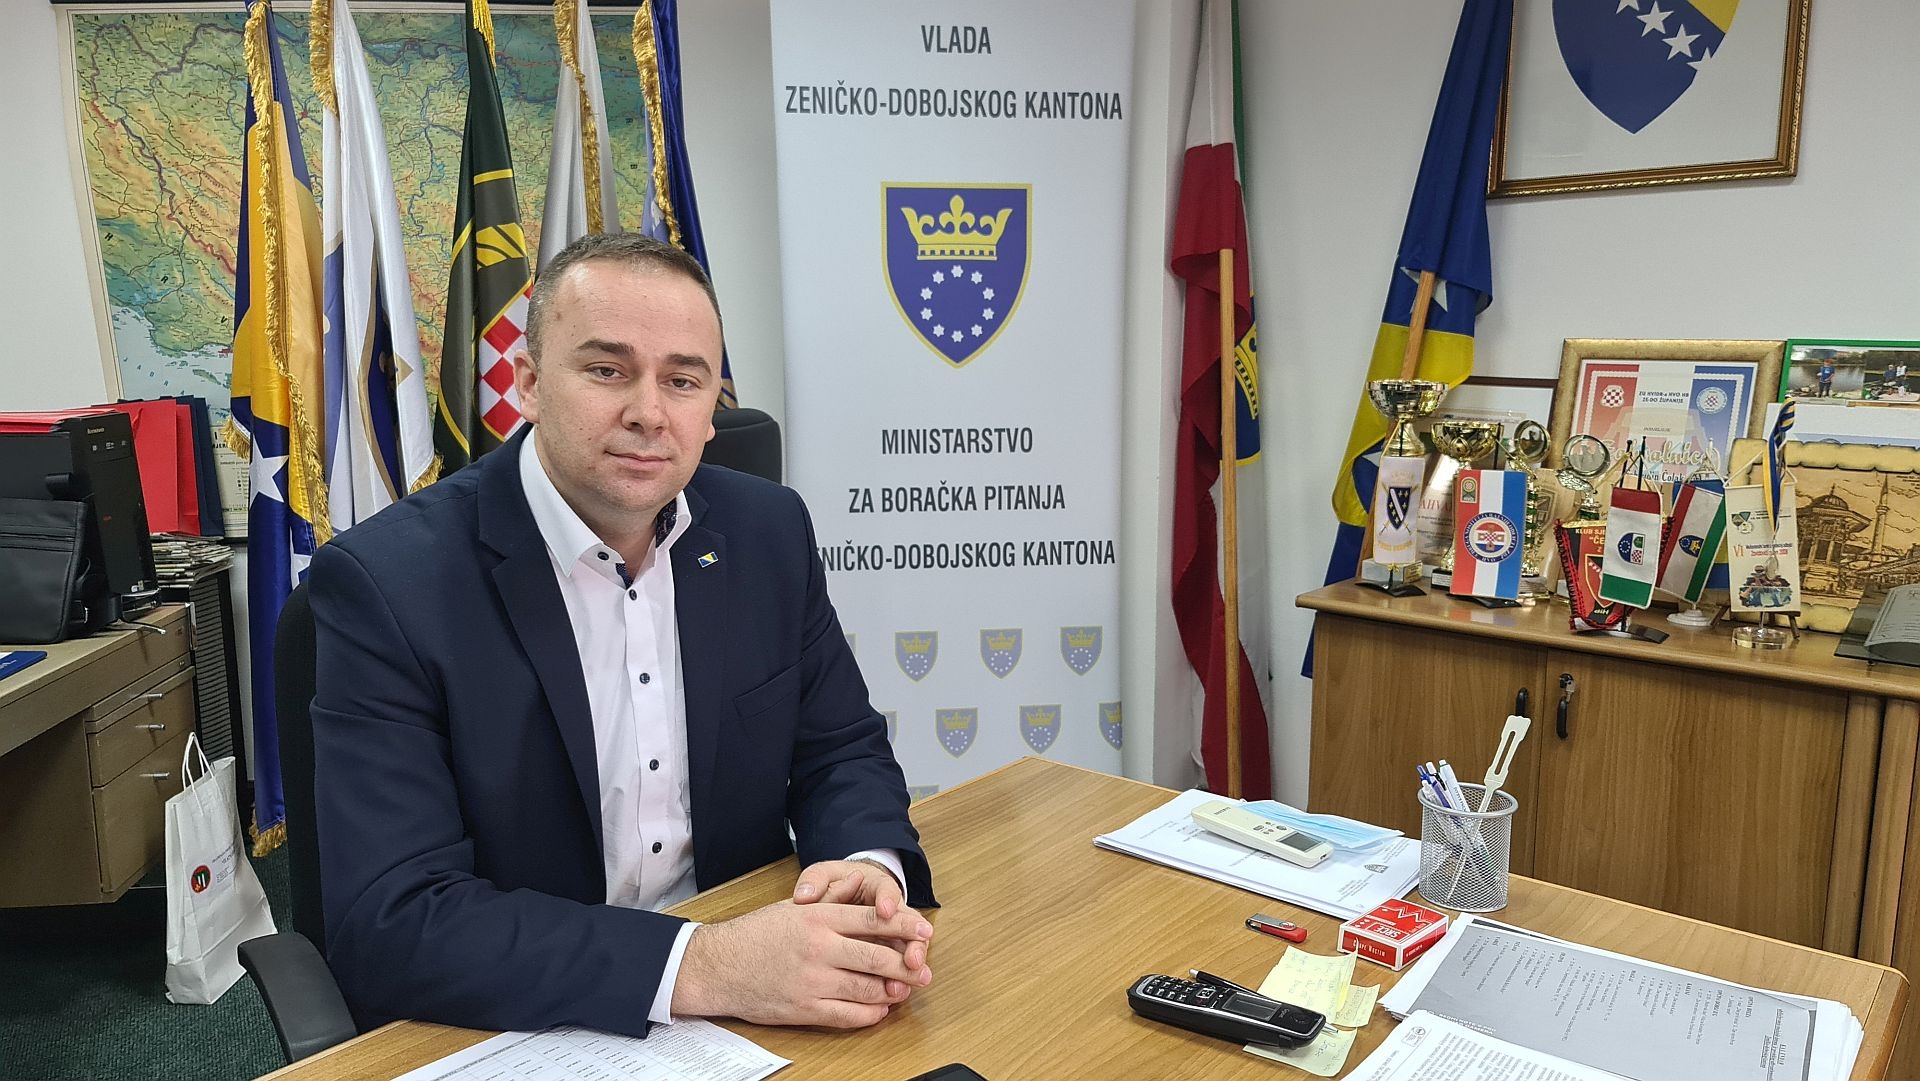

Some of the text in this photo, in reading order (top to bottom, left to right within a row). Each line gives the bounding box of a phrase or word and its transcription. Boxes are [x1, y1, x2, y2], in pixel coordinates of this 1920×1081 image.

[921, 25, 992, 54] VLADA
[785, 80, 1123, 120] ZENIČKO-DOBOJSKOG KANTONA
[881, 427, 1033, 455] MINISTARSTVO
[849, 480, 1066, 513] ZA BORAČKA PITANJA
[817, 540, 1116, 572] NIČKO-DOBOJSKOG KANTONA
[1373, 925, 1401, 938] SRCE
